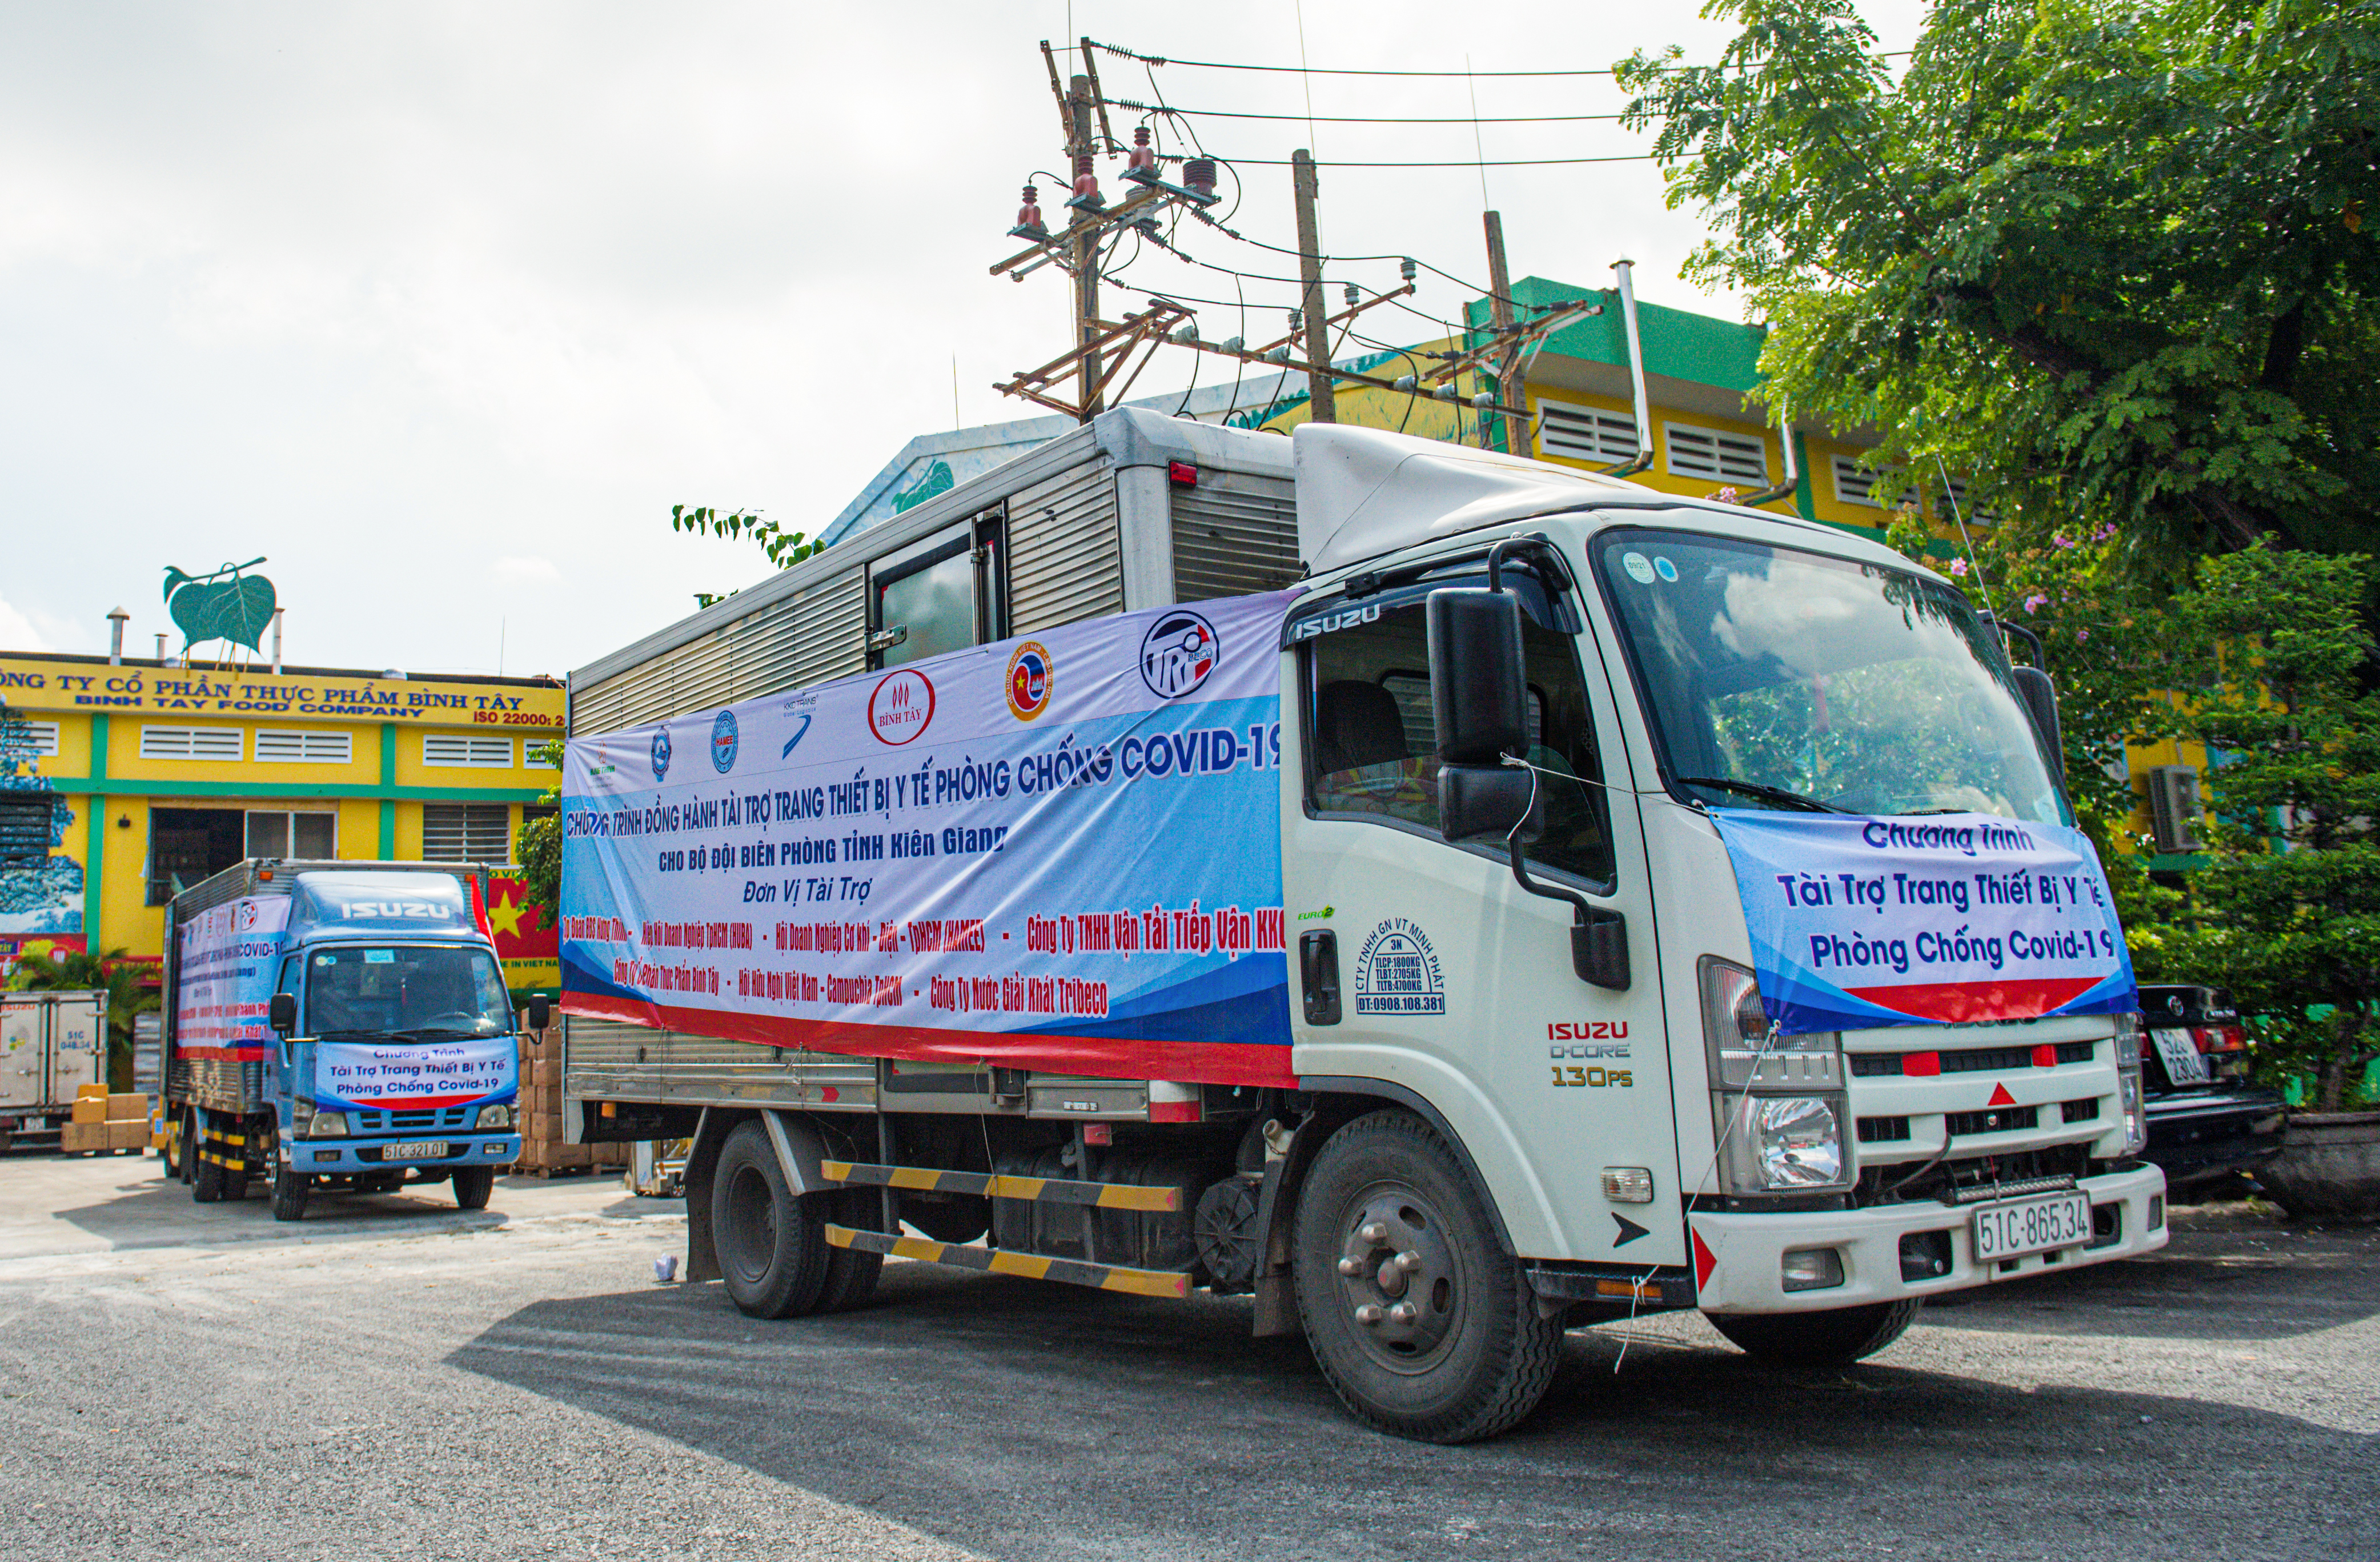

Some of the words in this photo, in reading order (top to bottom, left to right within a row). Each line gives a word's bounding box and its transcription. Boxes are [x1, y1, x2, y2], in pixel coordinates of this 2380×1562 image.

[1296, 603, 1381, 639] ISUZU
[1188, 648, 1213, 662] BECO
[1030, 643, 1041, 652] NAM
[1043, 653, 1052, 698] CAMPUCHIA
[0, 668, 46, 688] NG
[56, 675, 96, 691] TY
[106, 671, 143, 694] CỔ
[155, 675, 232, 698] PHẦN
[239, 683, 314, 703] THỰC
[323, 682, 398, 705] PHẨM
[407, 688, 468, 709] BÌNH
[473, 692, 524, 711] TÂY
[75, 695, 142, 706] BINH
[153, 698, 208, 709] TAY
[218, 700, 290, 711] FOOD
[299, 704, 425, 717] COMPANY
[473, 711, 497, 723] ISO
[503, 713, 551, 726] 22000:
[880, 711, 901, 727] BÌNH
[904, 707, 922, 723] TÂY
[716, 735, 733, 747] HAMEE
[613, 803, 641, 836] TRÌNH
[645, 794, 679, 834] ĐỒNG
[683, 795, 717, 831] HÀNH
[721, 790, 741, 826] TÀI
[745, 789, 770, 831] TRỢ
[775, 787, 824, 821] TRANG
[829, 766, 870, 816] THIẾT
[874, 777, 890, 819] BỊ
[895, 775, 907, 808] Y
[911, 755, 933, 806] TẾ
[936, 755, 1010, 803] PHÒNG
[1018, 733, 1113, 795] CHỐNG
[1863, 823, 1976, 856] Chương
[1978, 824, 2035, 851] Trình
[659, 850, 684, 872] CHO
[689, 844, 707, 874] BỘ
[711, 843, 736, 873] ĐỘI
[741, 840, 775, 867] BIÊN
[781, 836, 836, 866] PHÒNG
[842, 829, 884, 862] TỈNH
[891, 829, 935, 859] Kiên
[942, 826, 1009, 855] Giang
[743, 880, 776, 903] Đơn
[783, 879, 800, 907] Vị
[806, 876, 834, 902] Tài
[840, 876, 873, 906] Trợ
[1777, 872, 1832, 907] Tài
[1838, 873, 1885, 913] Trợ
[1893, 873, 1969, 913] Trang
[1975, 868, 2032, 904] Thiết
[2039, 875, 2060, 913] Bị
[2063, 877, 2077, 904] Y
[343, 902, 450, 919] ISUZU
[664, 922, 682, 947] Doanh
[684, 920, 705, 953] Nghiệp
[706, 922, 728, 950] TpHCM
[729, 922, 752, 951] (HUBA)
[776, 920, 788, 956] Hội
[790, 923, 812, 951] Doanh
[815, 922, 842, 958] Nghiệp
[844, 922, 855, 952] Cơ
[879, 920, 898, 959] Điện
[908, 920, 942, 955] TpHCM
[943, 919, 985, 954] (HAMEE)
[1028, 914, 1056, 954] Công
[1060, 916, 1074, 954] Ty
[1078, 914, 1110, 950] TNHH
[1114, 911, 1138, 958] Vận
[1143, 906, 1167, 950] Tải
[1174, 902, 1210, 953] Tiếp
[1217, 908, 1250, 958] Vận
[1378, 919, 1392, 934] GN
[1395, 918, 1408, 931] VT
[240, 941, 283, 957] COVID-1
[1359, 930, 1379, 964] TNHH
[1391, 939, 1402, 950] 3N
[1409, 923, 1434, 955] MINH
[1809, 931, 1909, 974] Phòng
[1916, 924, 2004, 970] Chống
[2009, 929, 2114, 959] Covid-19
[1375, 956, 1420, 968] TLCP:1800KG
[1428, 955, 1445, 989] PHÁT
[1355, 966, 1365, 990] CTY
[1375, 968, 1421, 979] TLBT:2705KG
[675, 959, 691, 991] Phẩm
[693, 965, 706, 992] Bình
[708, 966, 719, 996] Tây
[739, 967, 750, 1002] Hội
[752, 968, 765, 998] Hữu
[768, 971, 783, 1006] Nghị
[785, 970, 800, 1007] Việt
[801, 972, 818, 1002] Nam
[827, 974, 872, 1007] Campuchia
[875, 975, 902, 1008] TpHCM
[930, 974, 955, 1012] Công
[958, 977, 969, 1012] Ty
[972, 975, 999, 1012] Nước
[1002, 971, 1024, 1012] Giải
[1028, 975, 1055, 1013] Khát
[1058, 978, 1107, 1015] Tribeco
[1376, 980, 1422, 991] TLTB:4700KG
[1359, 997, 1443, 1011] ĐT:0908.108.381
[68, 1031, 84, 1039] 51C
[1548, 1022, 1628, 1040] ISUZU
[374, 1050, 429, 1059] Chương
[433, 1048, 465, 1057] Trình
[331, 1066, 351, 1076] Tài
[356, 1066, 376, 1078] Trợ
[381, 1065, 420, 1076] Trang
[425, 1061, 457, 1073] Thiết
[462, 1063, 474, 1075] Bị
[479, 1062, 487, 1071] Y
[491, 1058, 506, 1070] Tế
[1551, 1066, 1632, 1087] 130PS
[337, 1083, 382, 1095] Phòng
[387, 1080, 434, 1095] Chống
[439, 1078, 499, 1091] Covid-19
[385, 1144, 445, 1158] 51C-321.01
[1979, 1199, 2088, 1252] 51C-865.34
